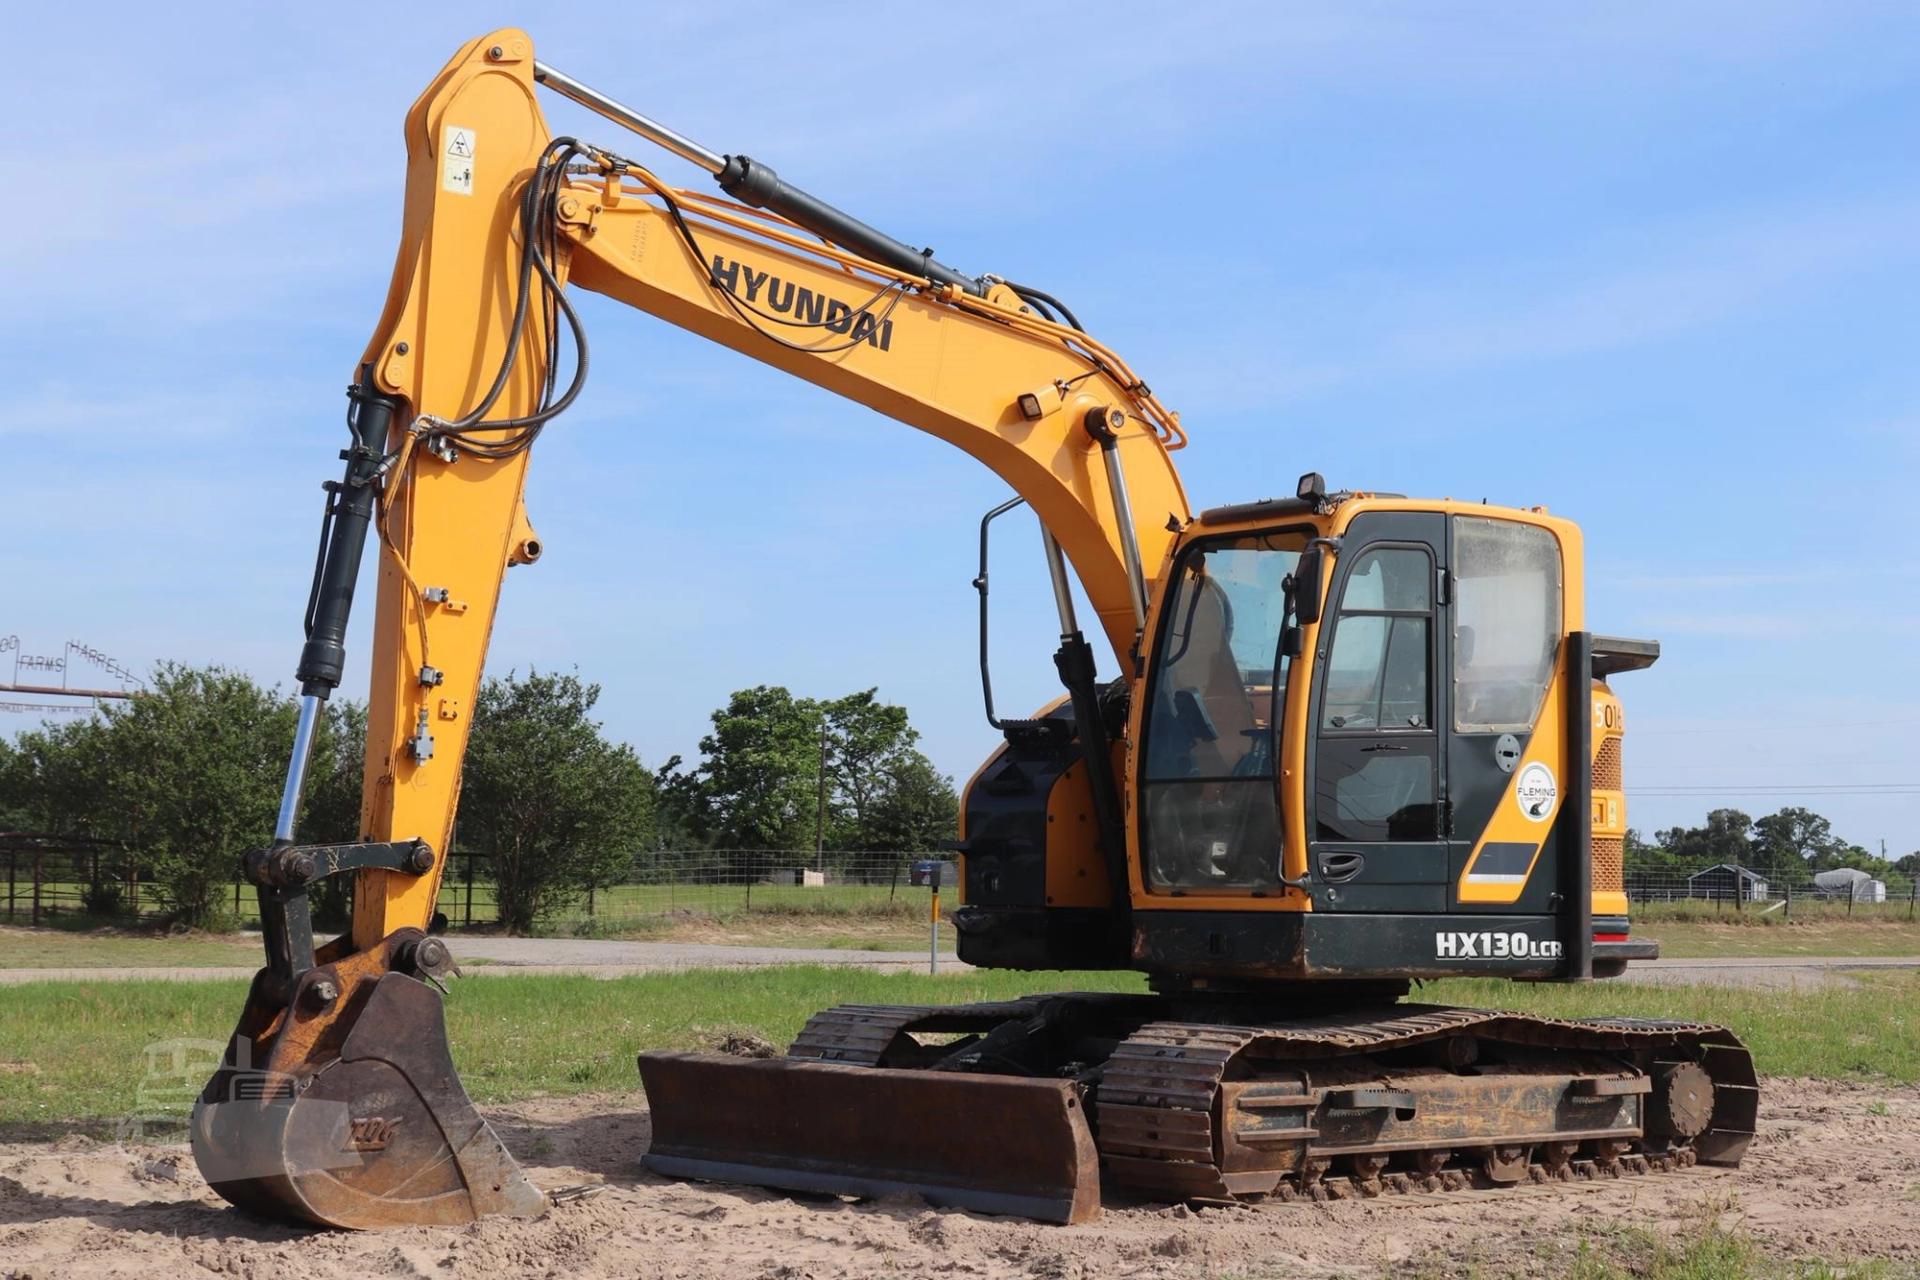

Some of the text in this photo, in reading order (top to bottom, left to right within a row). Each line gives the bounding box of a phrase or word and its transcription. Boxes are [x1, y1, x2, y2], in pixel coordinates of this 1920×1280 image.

[712, 254, 894, 353] HYUNDAI
[19, 655, 65, 673] FARMS
[69, 638, 134, 683] HARRELL
[1517, 787, 1556, 797] FLEMING
